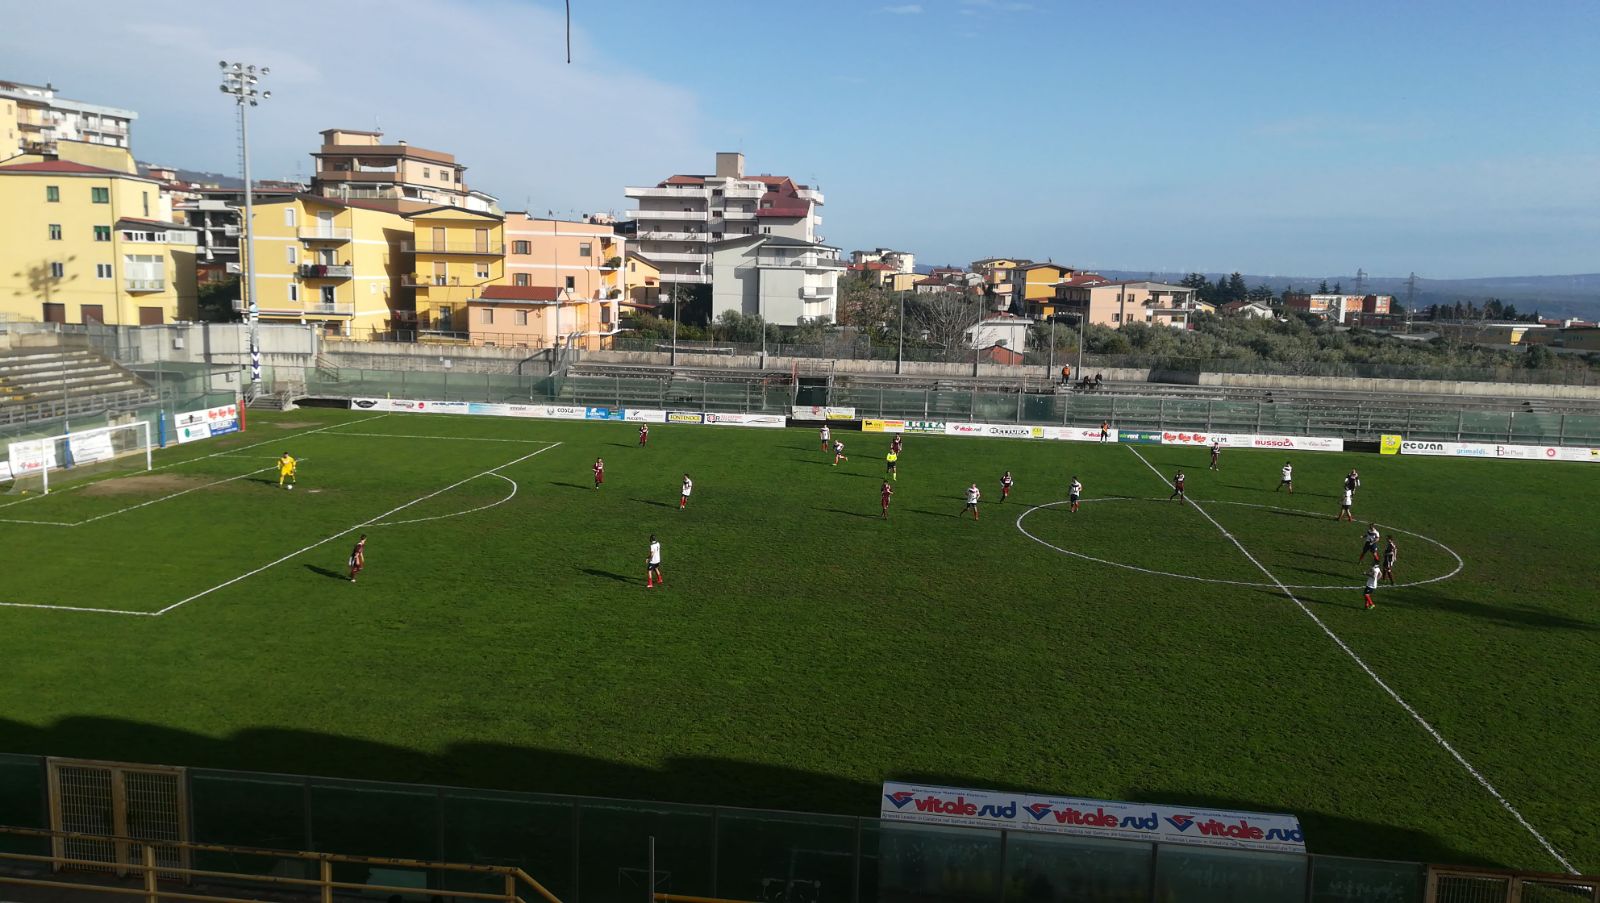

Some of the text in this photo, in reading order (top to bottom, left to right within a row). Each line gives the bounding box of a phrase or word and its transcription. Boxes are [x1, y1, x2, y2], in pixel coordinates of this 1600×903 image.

[1402, 442, 1443, 451] ecosan
[914, 796, 1017, 819] vitale sud
[1053, 807, 1159, 831] vitale sud
[1196, 818, 1305, 842] vitale sud
